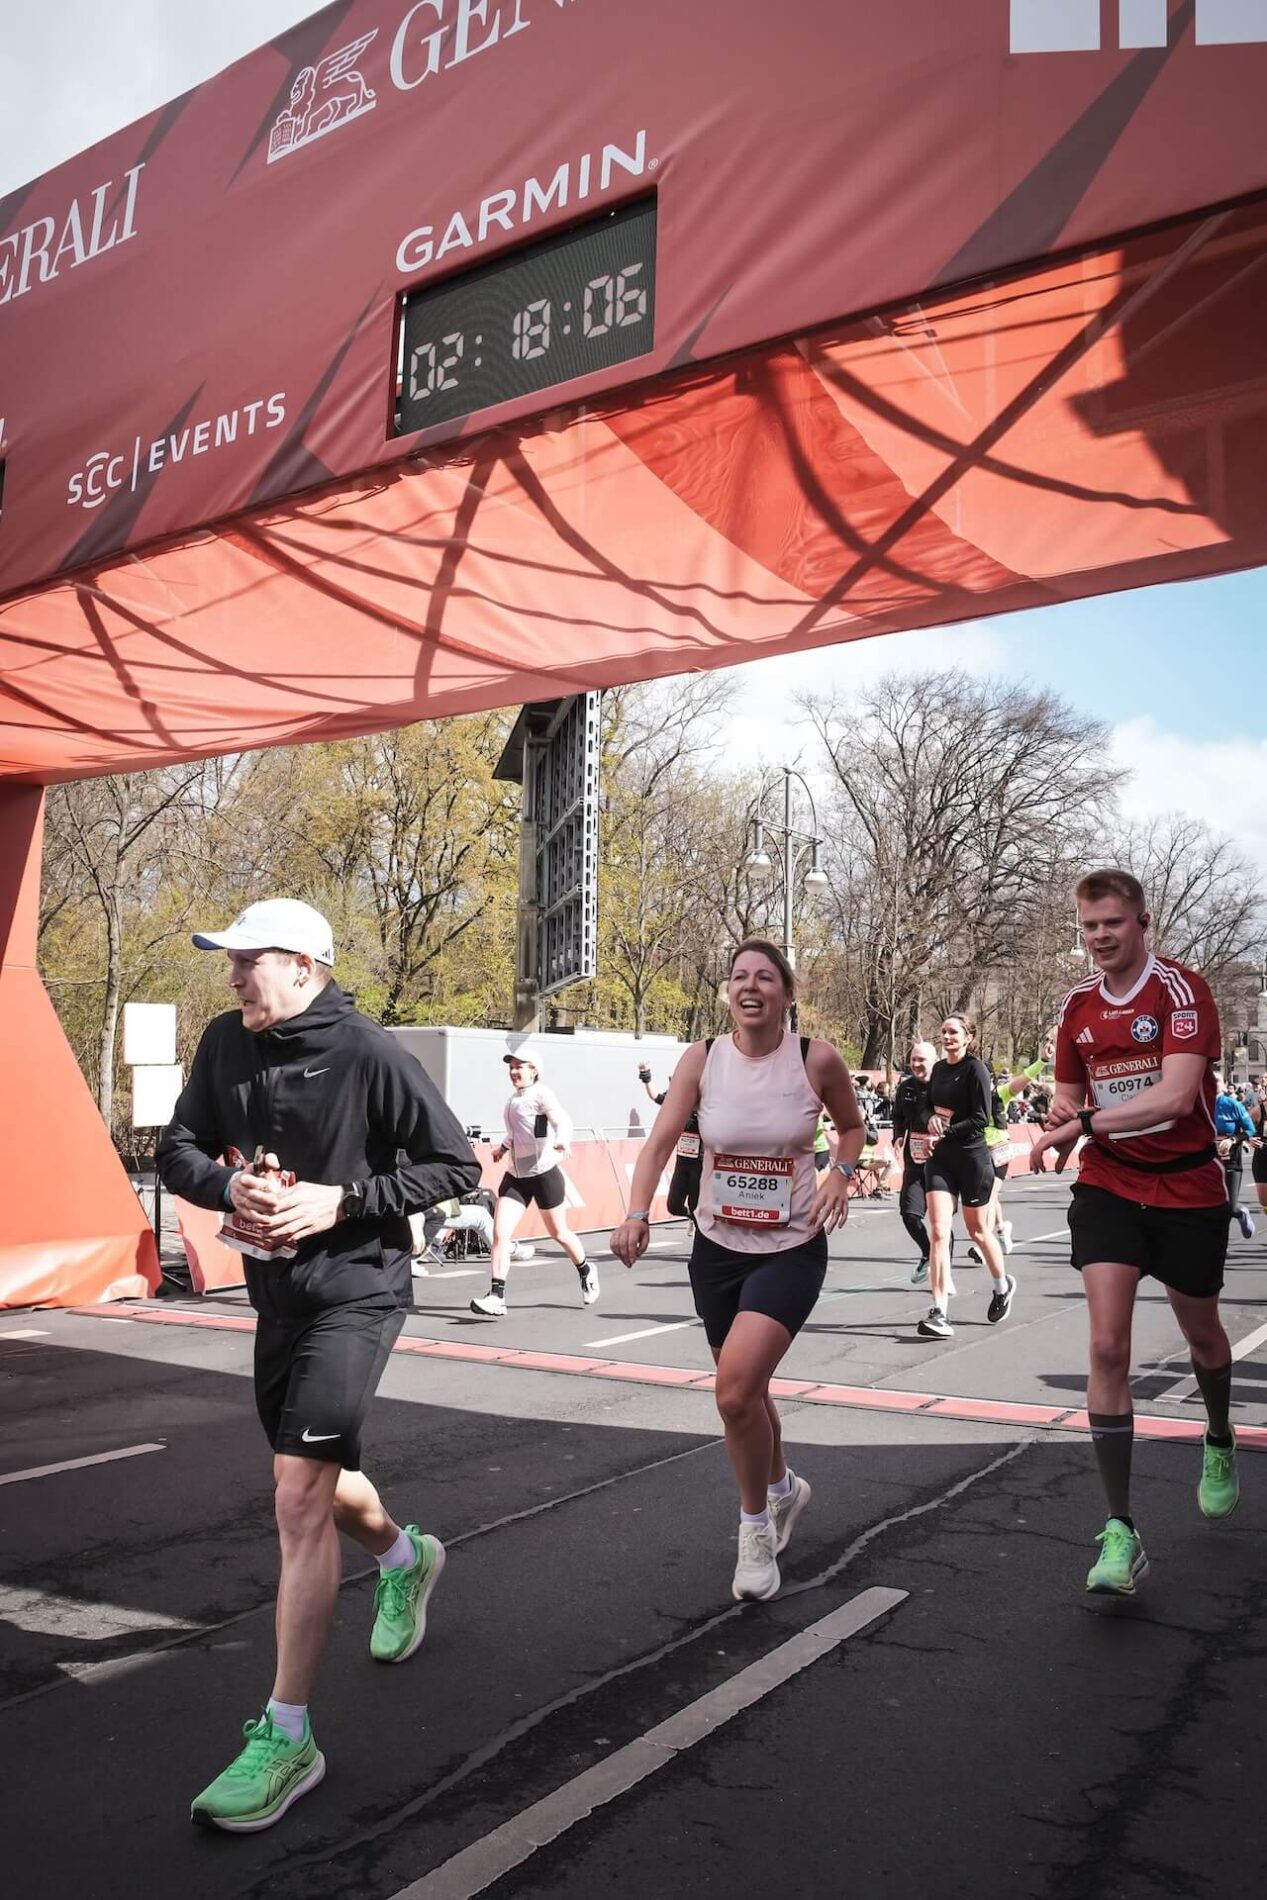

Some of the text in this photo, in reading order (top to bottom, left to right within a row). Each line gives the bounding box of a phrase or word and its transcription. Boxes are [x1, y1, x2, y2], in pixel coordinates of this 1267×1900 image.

[66, 392, 286, 509] SCC EVENTS
[1109, 1056, 1158, 1075] GENERALI
[1109, 1076, 1154, 1095] 60974
[734, 1159, 788, 1172] GENERALI
[727, 1175, 778, 1191] 65288
[738, 1190, 765, 1201] Aniek
[731, 1207, 769, 1219] bett1.de
